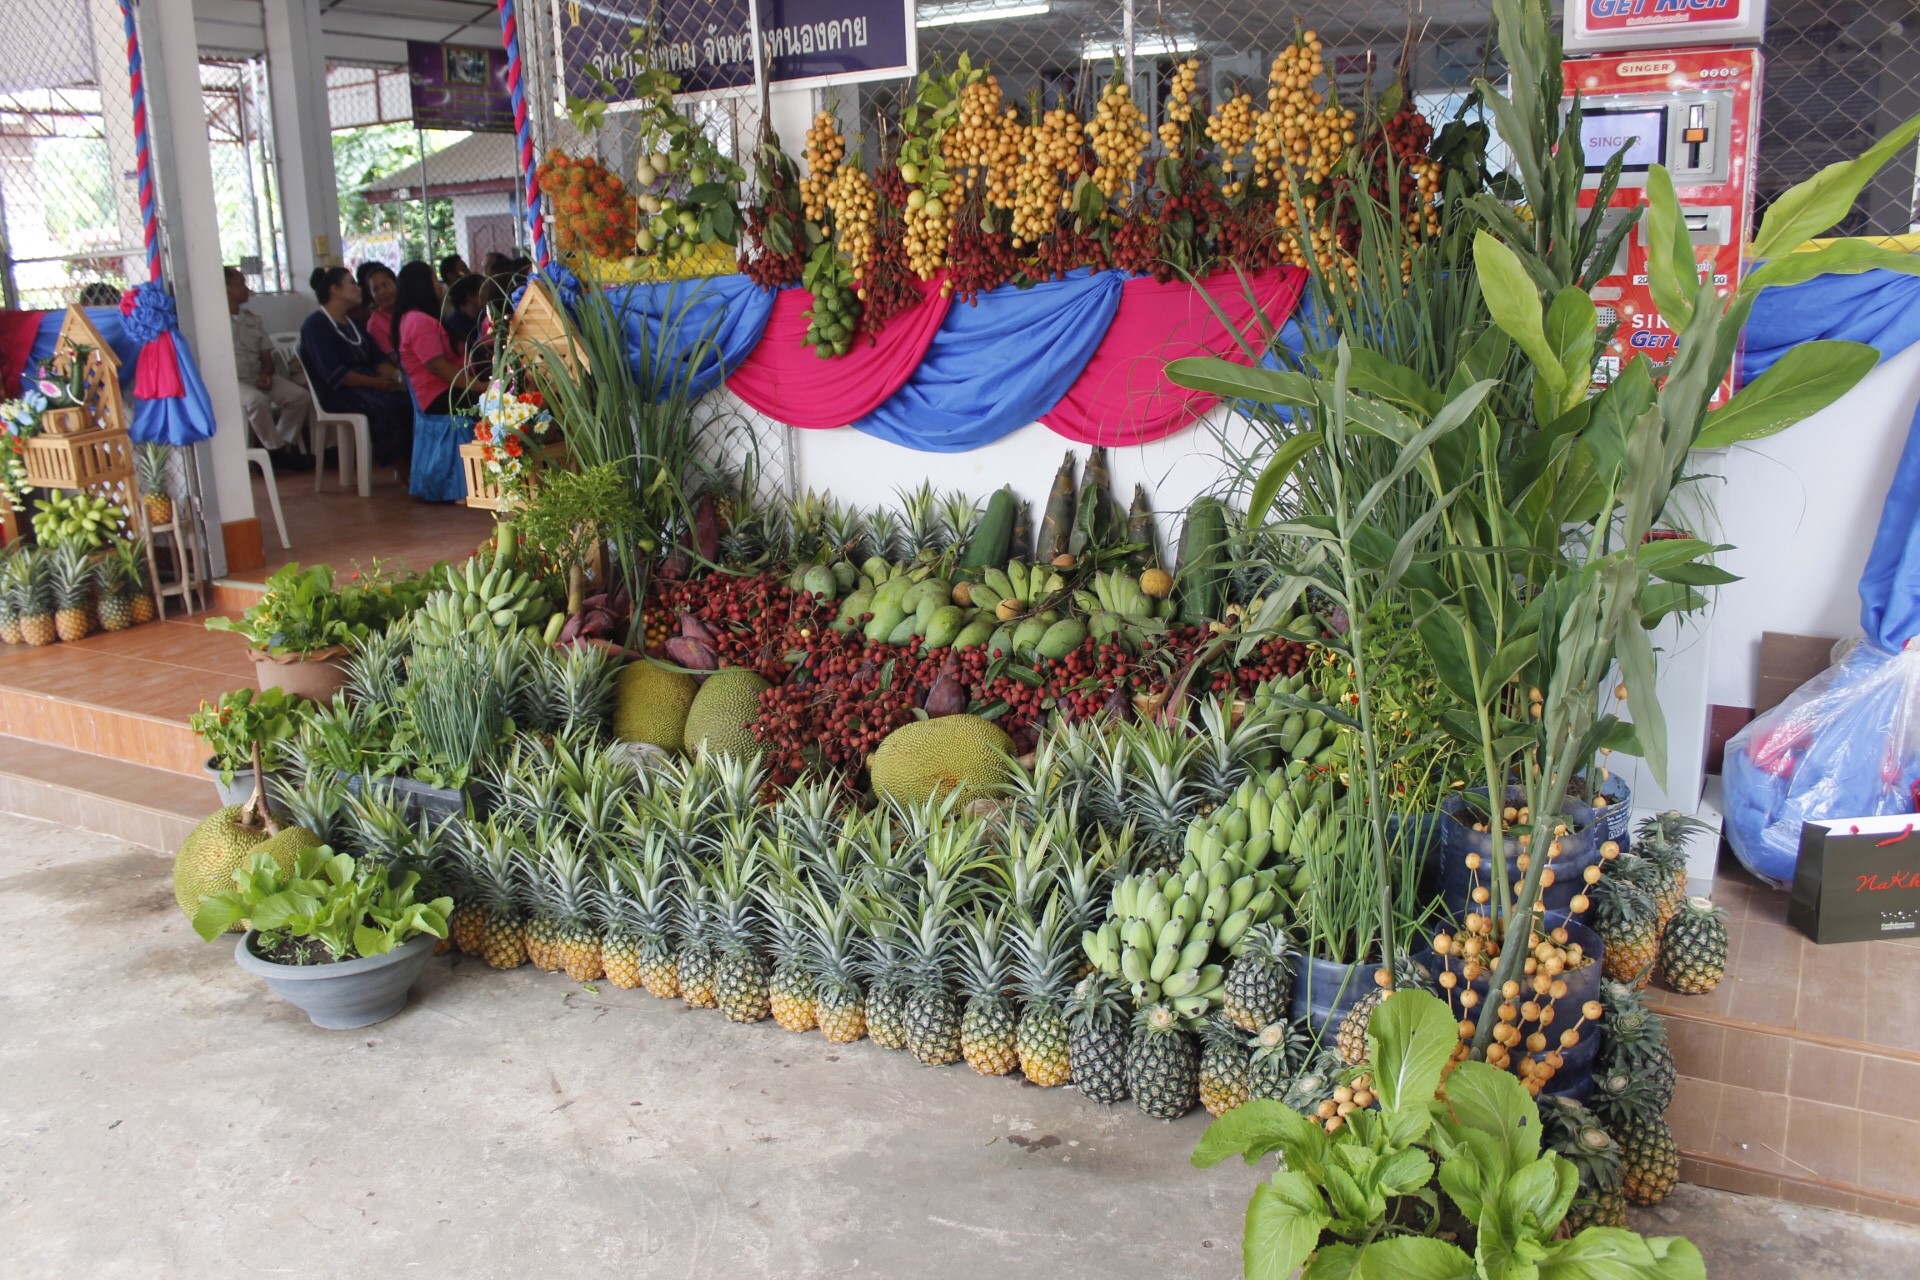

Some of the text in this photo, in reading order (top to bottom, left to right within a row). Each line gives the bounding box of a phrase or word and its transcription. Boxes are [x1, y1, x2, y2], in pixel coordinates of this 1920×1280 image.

[703, 16, 868, 66] จังหวัหนองคาย
[1621, 63, 1670, 74] SINGER
[1589, 136, 1642, 148] SINGR
[1630, 330, 1671, 348] GET
